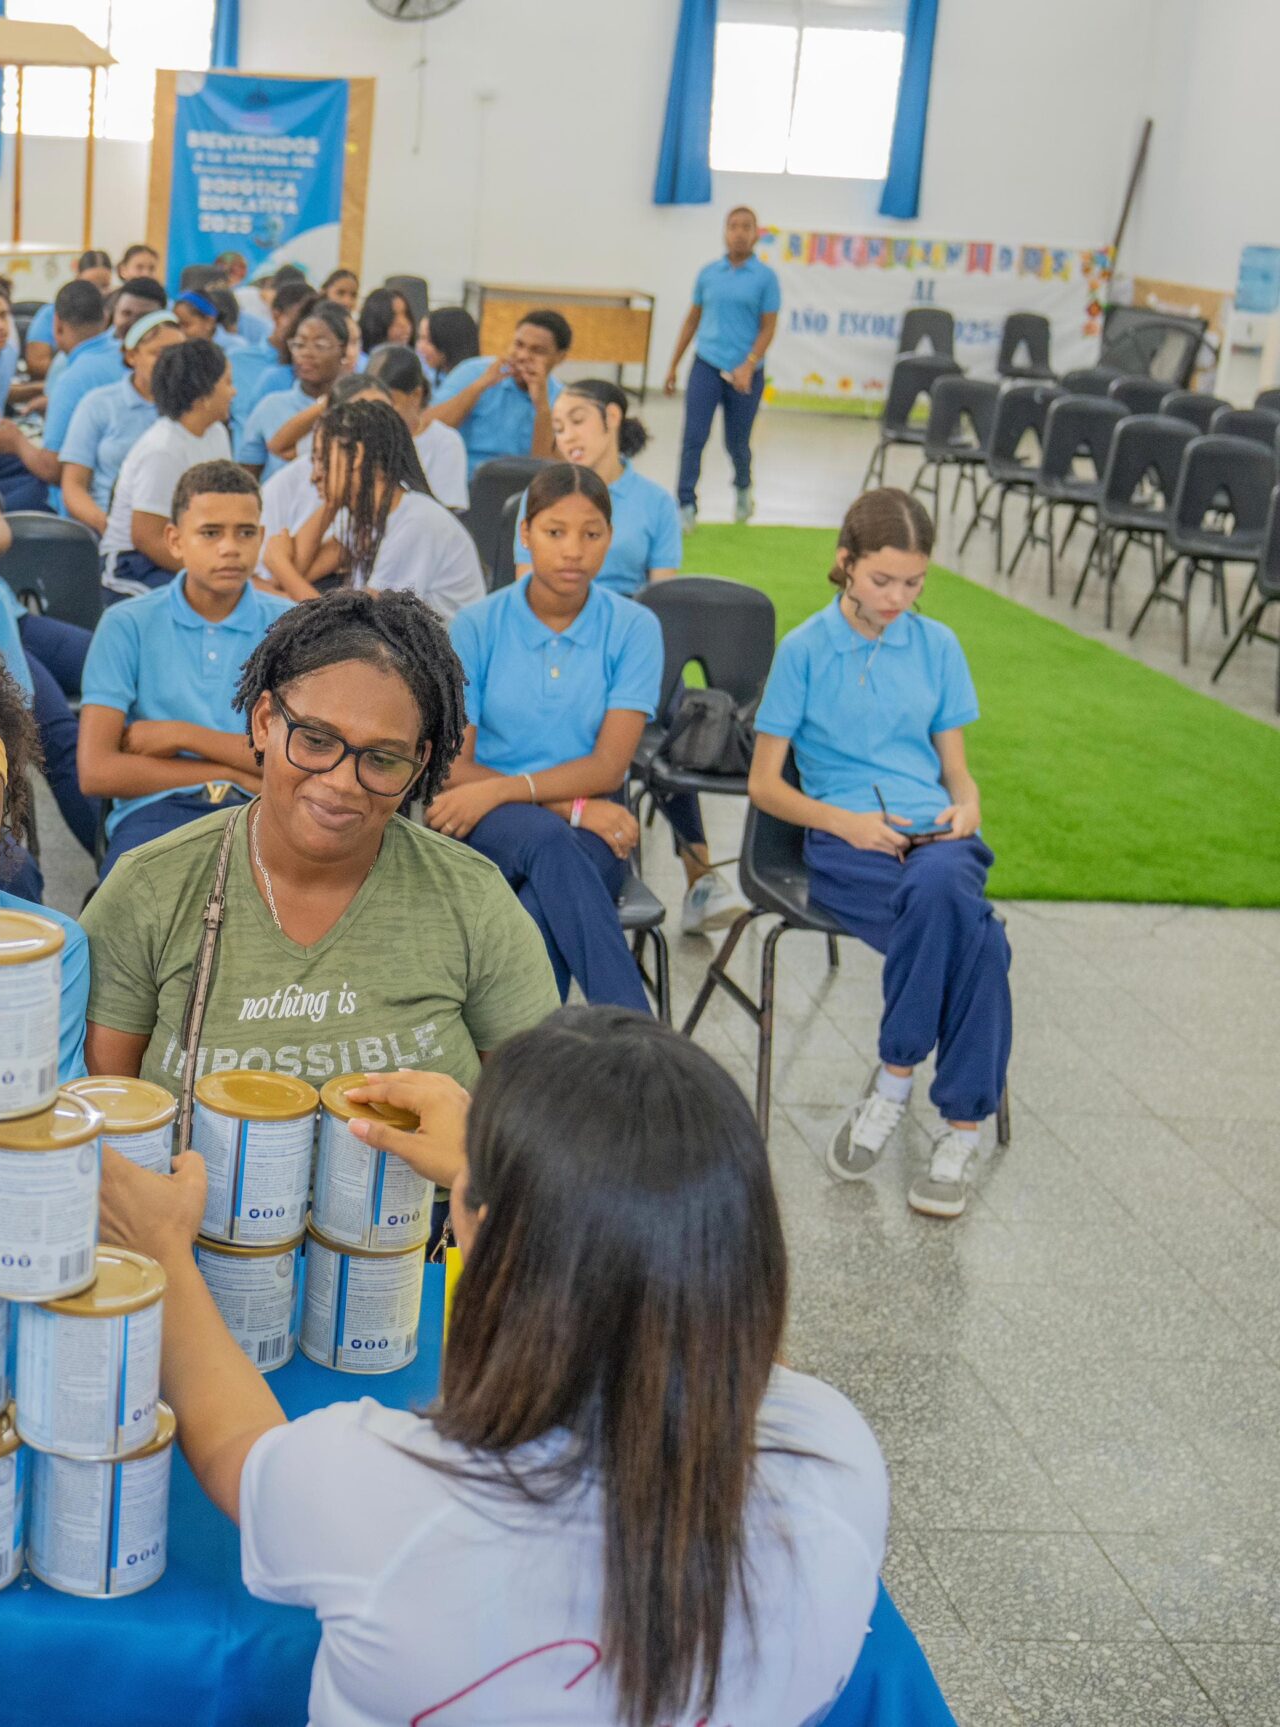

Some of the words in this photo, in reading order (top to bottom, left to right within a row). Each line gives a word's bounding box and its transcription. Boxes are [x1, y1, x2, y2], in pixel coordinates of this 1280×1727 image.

[187, 130, 319, 155] BIENVENIDOS
[198, 194, 299, 215] EDUCATIVA
[238, 984, 331, 1023] nothing
[338, 981, 357, 1015] is
